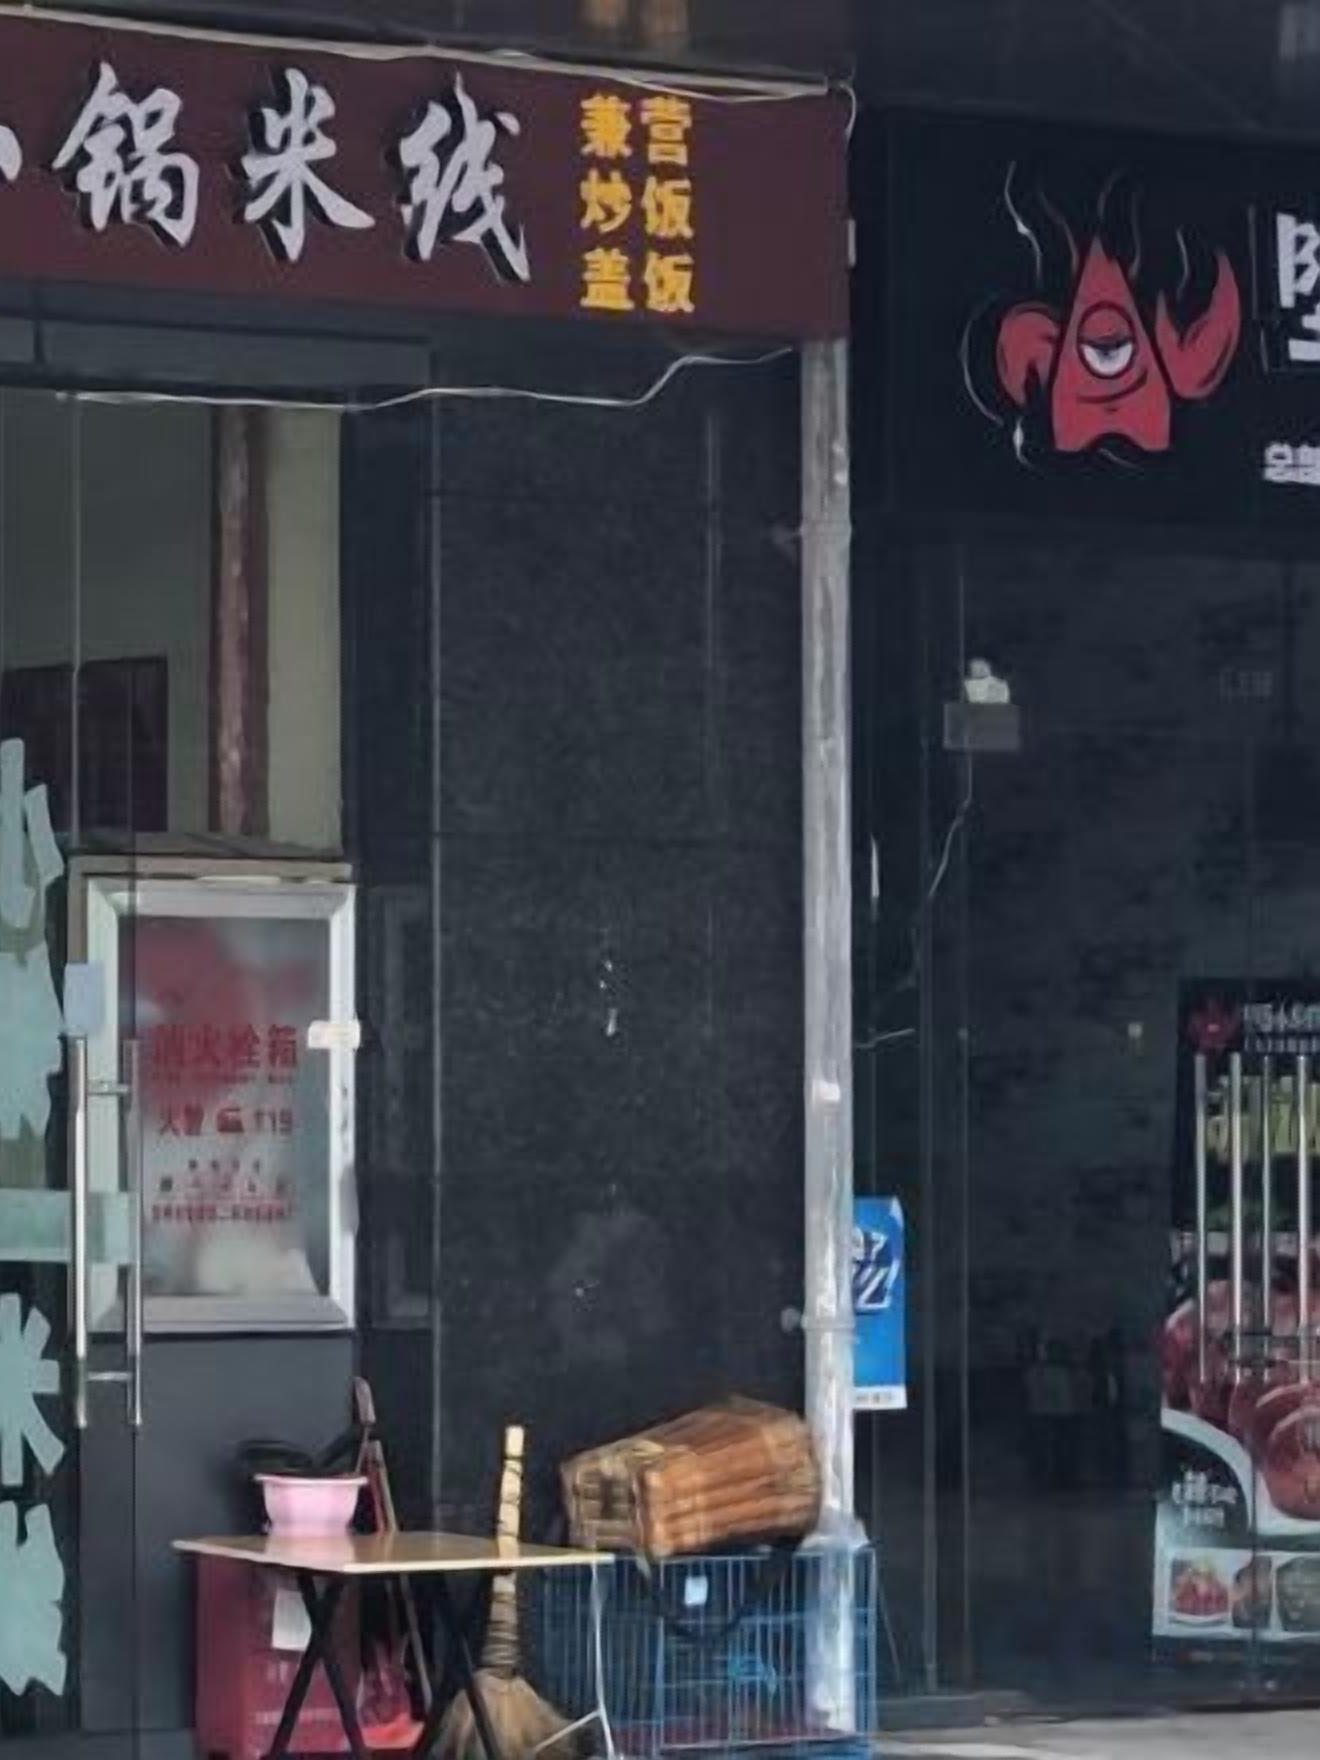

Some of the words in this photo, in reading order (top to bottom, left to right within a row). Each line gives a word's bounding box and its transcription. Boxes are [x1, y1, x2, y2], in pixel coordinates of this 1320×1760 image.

[580, 94, 692, 165] 兼营
[580, 168, 694, 238] 炒饭
[580, 247, 695, 312] 盖饭
